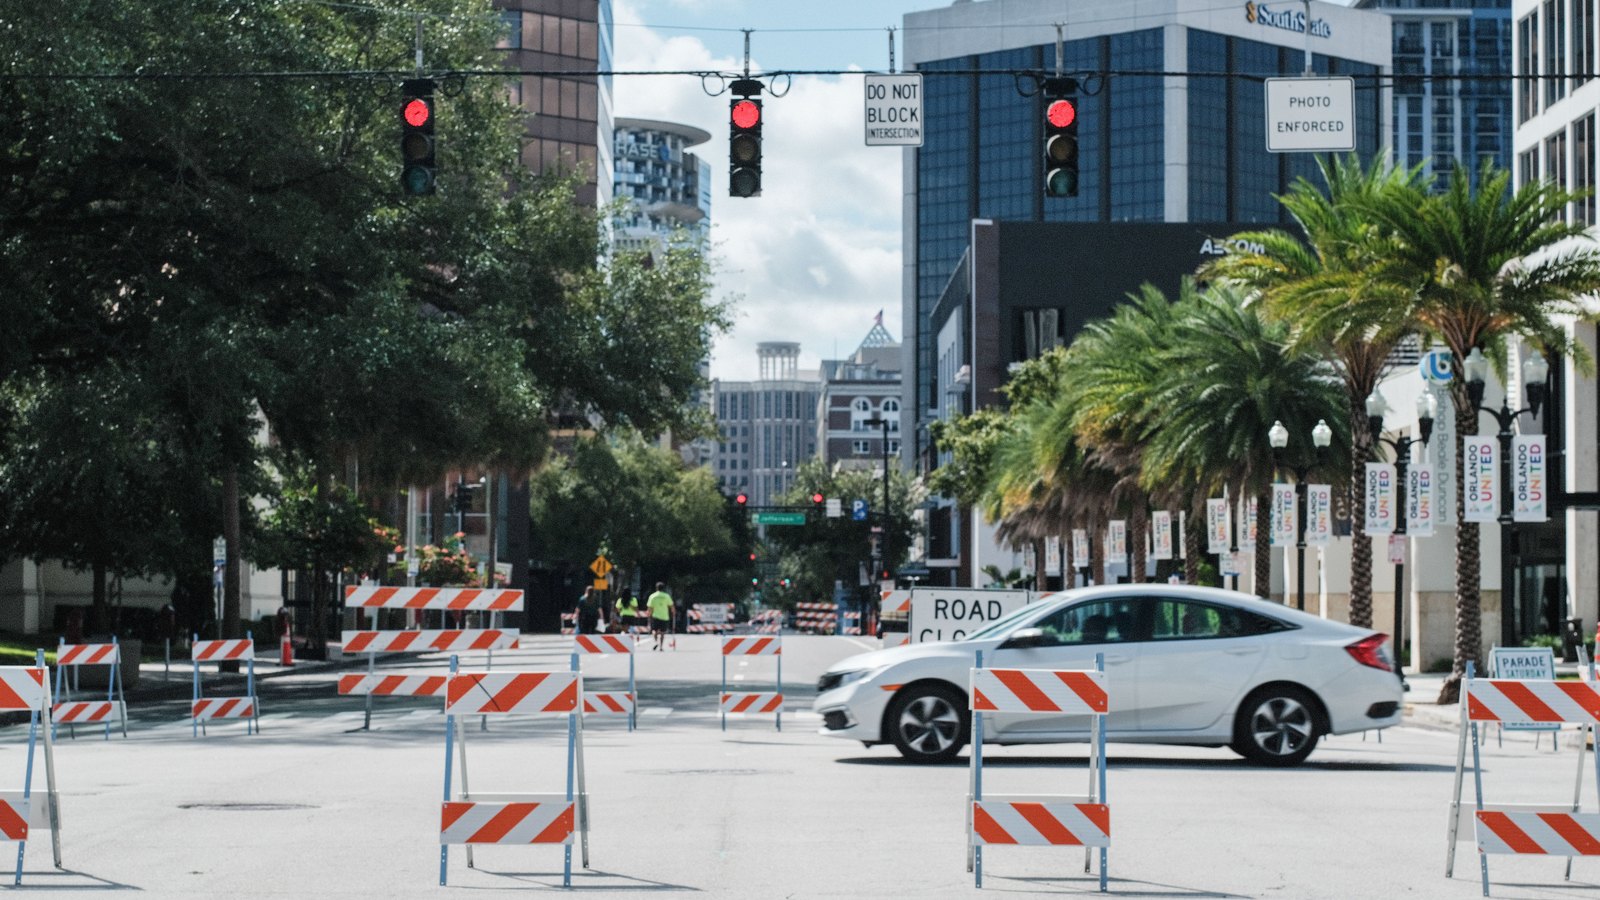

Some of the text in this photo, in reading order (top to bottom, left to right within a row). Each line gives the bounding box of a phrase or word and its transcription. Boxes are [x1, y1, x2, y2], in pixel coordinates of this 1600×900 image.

[1257, 4, 1332, 39] SouthSate
[867, 84, 918, 100] DO NOT
[1289, 96, 1331, 108] PHOTO
[867, 107, 919, 122] BLOCK
[867, 127, 920, 138] INTERSECTION
[1277, 120, 1344, 133] ENFORCED
[615, 143, 658, 158] HASE
[1437, 433, 1449, 470] Beale
[1469, 445, 1478, 502] ORLANDO
[1480, 445, 1492, 501] UNITED
[1519, 444, 1527, 501] ORLANDO
[1530, 444, 1542, 501] UNITED
[853, 500, 863, 513] P
[1284, 491, 1293, 532] UNITED
[1318, 491, 1328, 532] UNITED
[1369, 470, 1377, 518] ORLANDO
[1379, 470, 1389, 518] UNITED
[1410, 471, 1418, 519] ORLANDO
[1420, 471, 1430, 519] UNITED
[1438, 472, 1449, 522] Duncan
[934, 599, 1002, 620] ROAD
[1502, 656, 1546, 668] PARADE
[1505, 669, 1546, 678] SATURDAY
